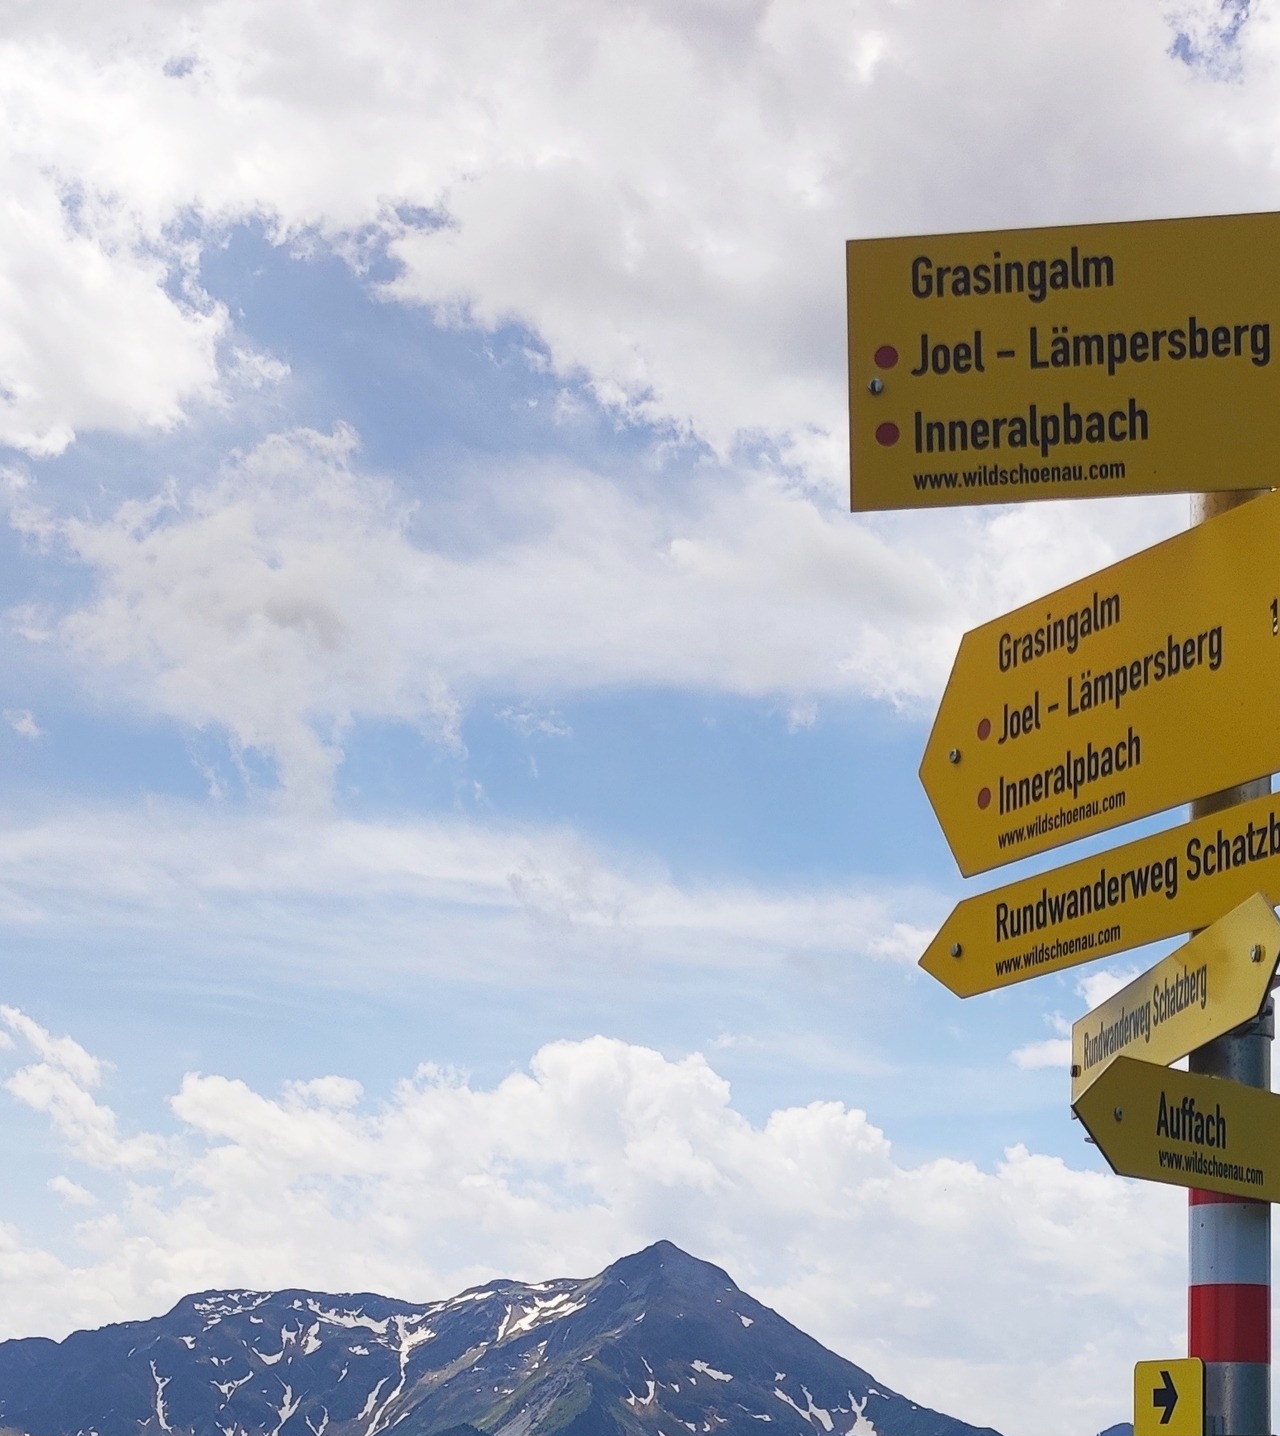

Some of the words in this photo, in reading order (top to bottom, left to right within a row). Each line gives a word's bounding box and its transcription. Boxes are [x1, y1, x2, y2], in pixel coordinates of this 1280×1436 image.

[912, 246, 1113, 303] Grasingalm
[911, 331, 984, 376] Joel
[1030, 317, 1270, 375] Lämpersberg
[915, 398, 1148, 457] Inneralpbach
[913, 463, 1125, 490] www.wildschoenau.com
[999, 592, 1120, 672] Grasingalm
[998, 691, 1040, 744] Joel
[1068, 626, 1222, 716] Lämpersberg
[999, 727, 1140, 815] Inneralpbach
[998, 790, 1125, 849] www.wildschoenau.com
[997, 855, 1177, 942] Rundwanderweg
[996, 925, 1120, 976] www.wildschoenau.com
[1084, 1000, 1150, 1070] Rundwanderweg
[1153, 964, 1207, 1026] Schatzberg
[1157, 1092, 1225, 1149] Auffach
[1159, 1150, 1263, 1185] www.wildschoenau.com
